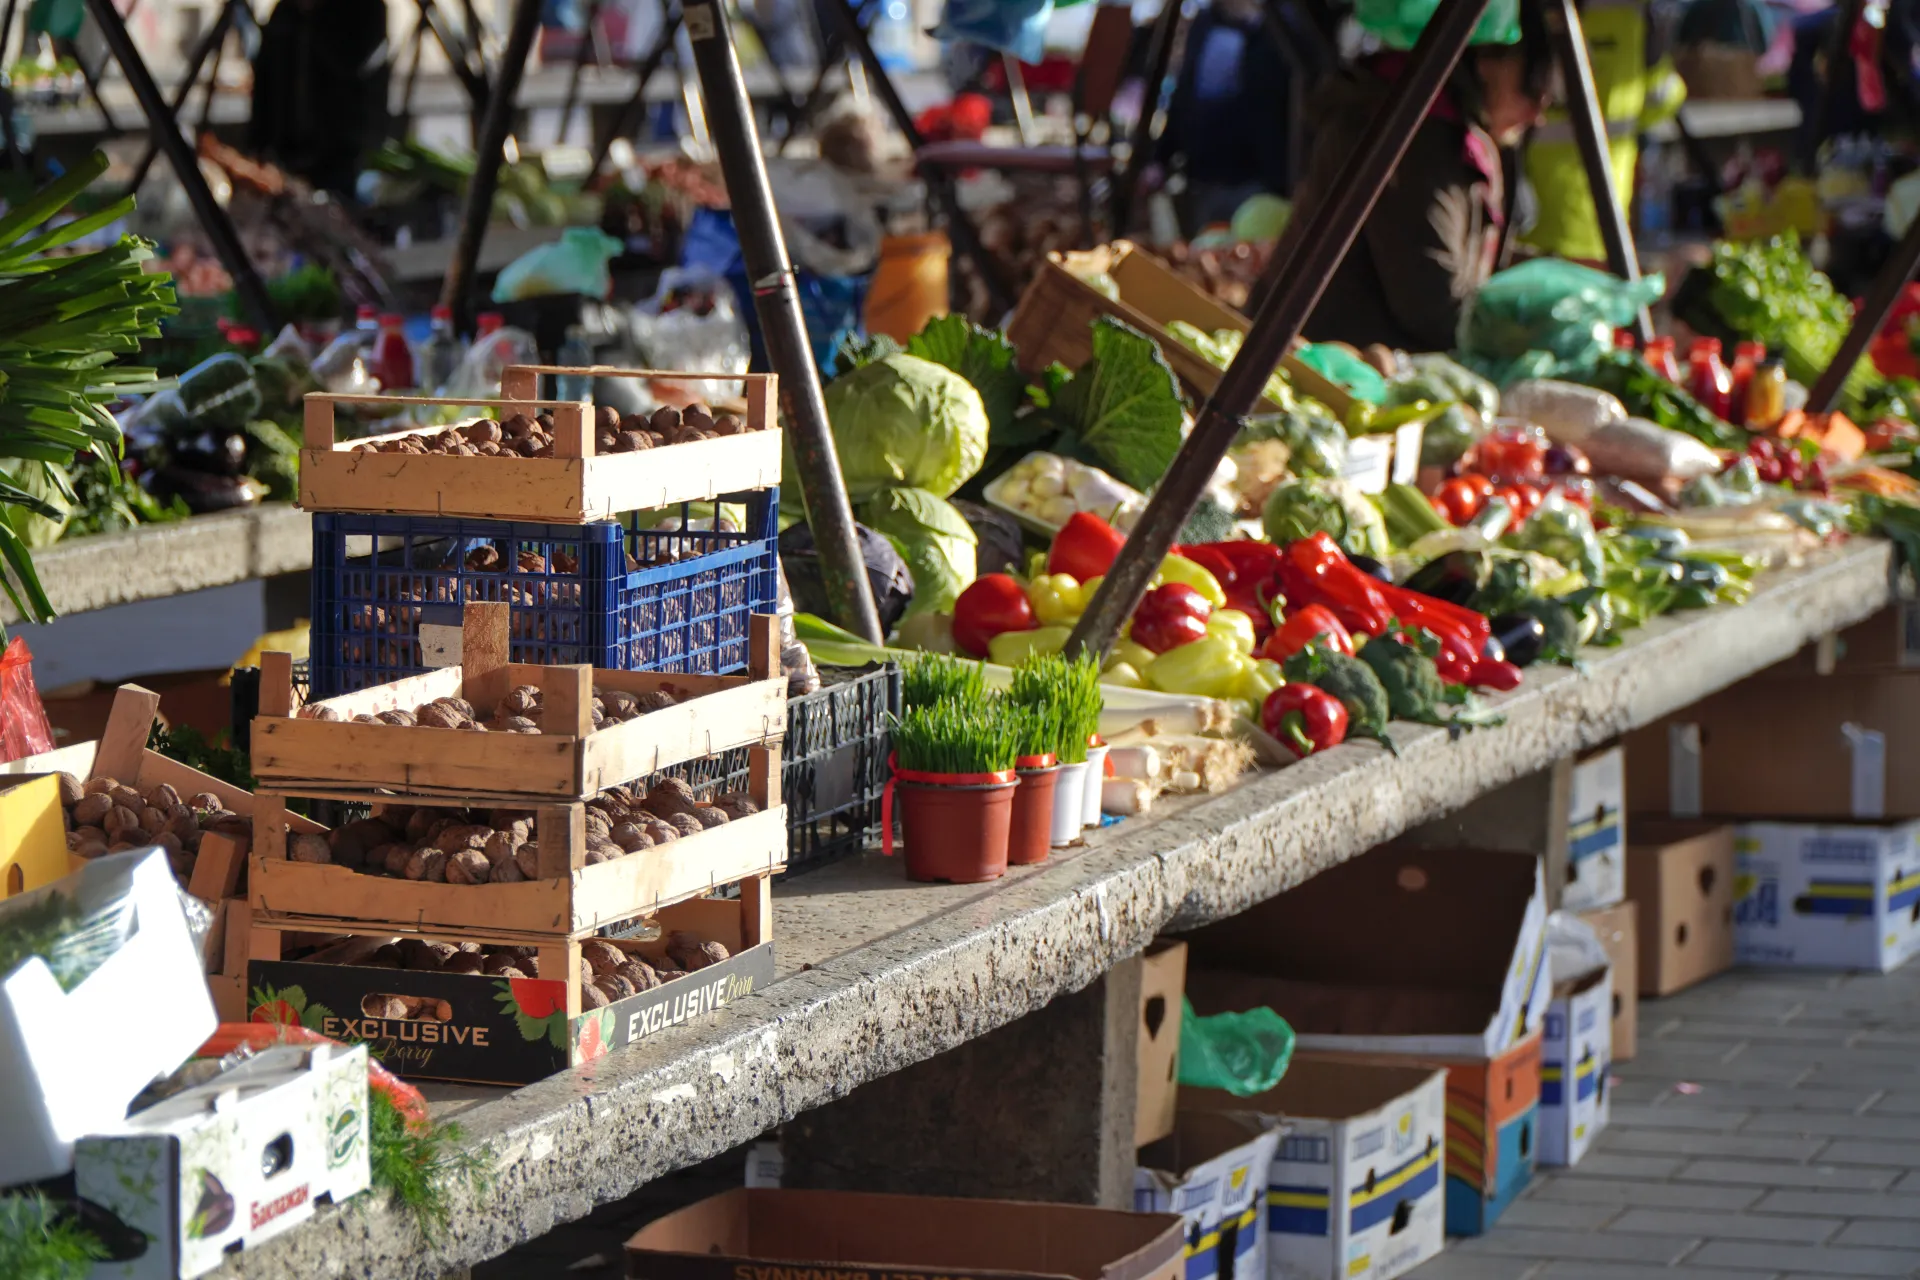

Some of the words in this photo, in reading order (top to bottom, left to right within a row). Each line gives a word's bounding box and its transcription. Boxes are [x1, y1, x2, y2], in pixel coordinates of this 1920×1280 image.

[627, 977, 727, 1043] EXCLUSIVE
[323, 1017, 489, 1046] EXCLUSIVE
[374, 1037, 434, 1068] Berry
